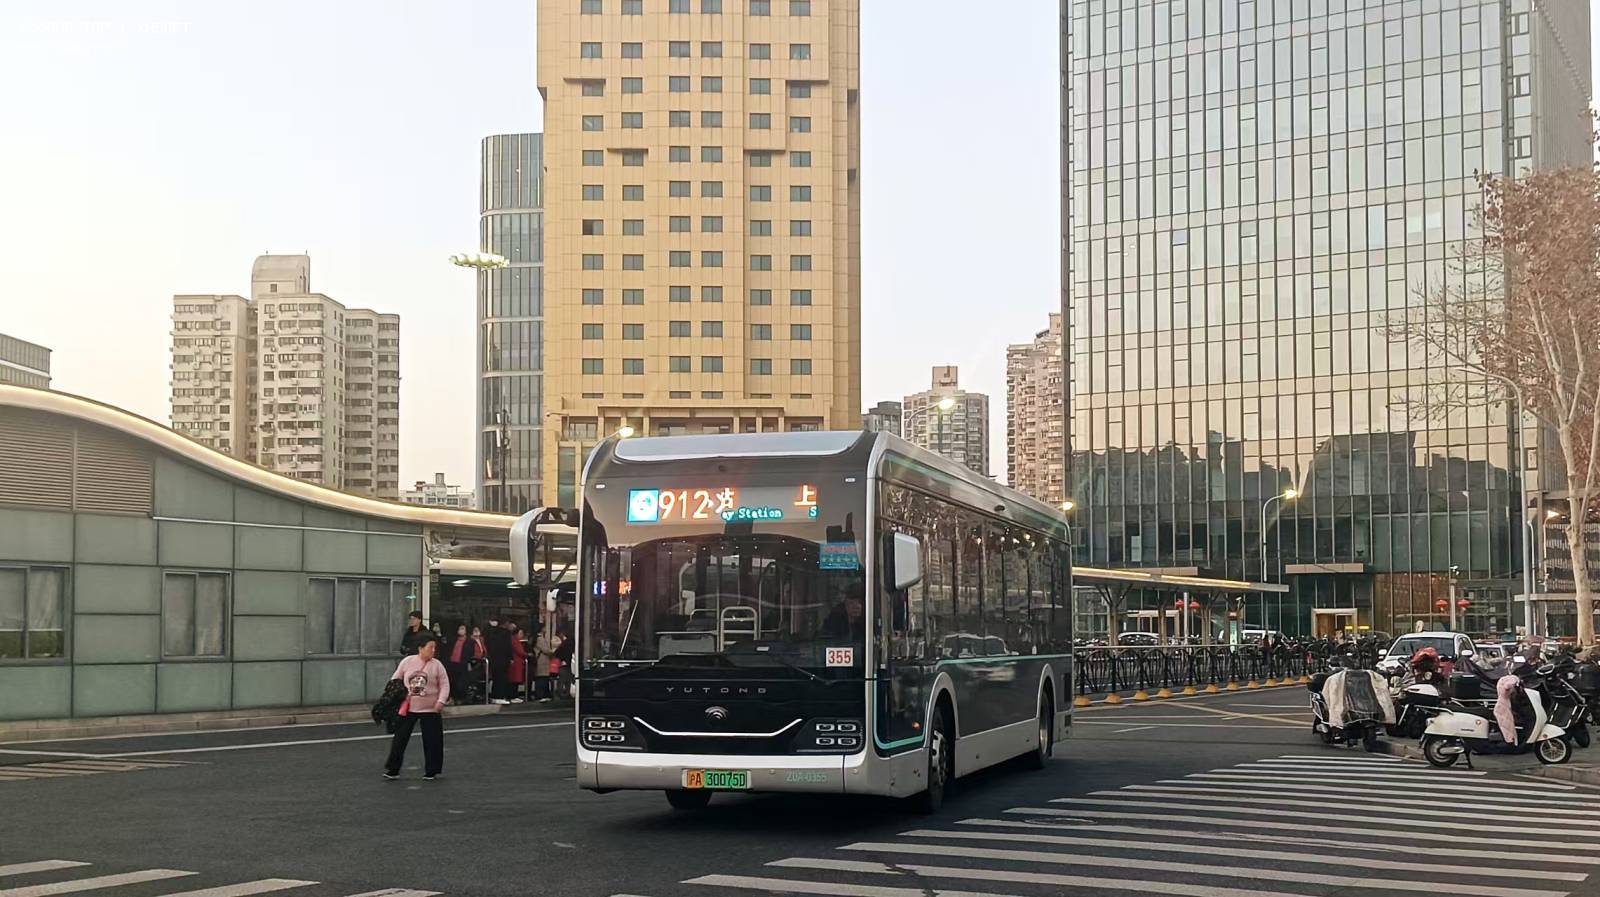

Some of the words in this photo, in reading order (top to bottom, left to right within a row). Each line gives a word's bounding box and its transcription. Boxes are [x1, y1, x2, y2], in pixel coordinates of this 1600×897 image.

[794, 485, 817, 506] 上
[658, 490, 708, 519] 912
[738, 507, 782, 519] Station
[828, 650, 851, 664] 355
[706, 772, 746, 787] 30075D
